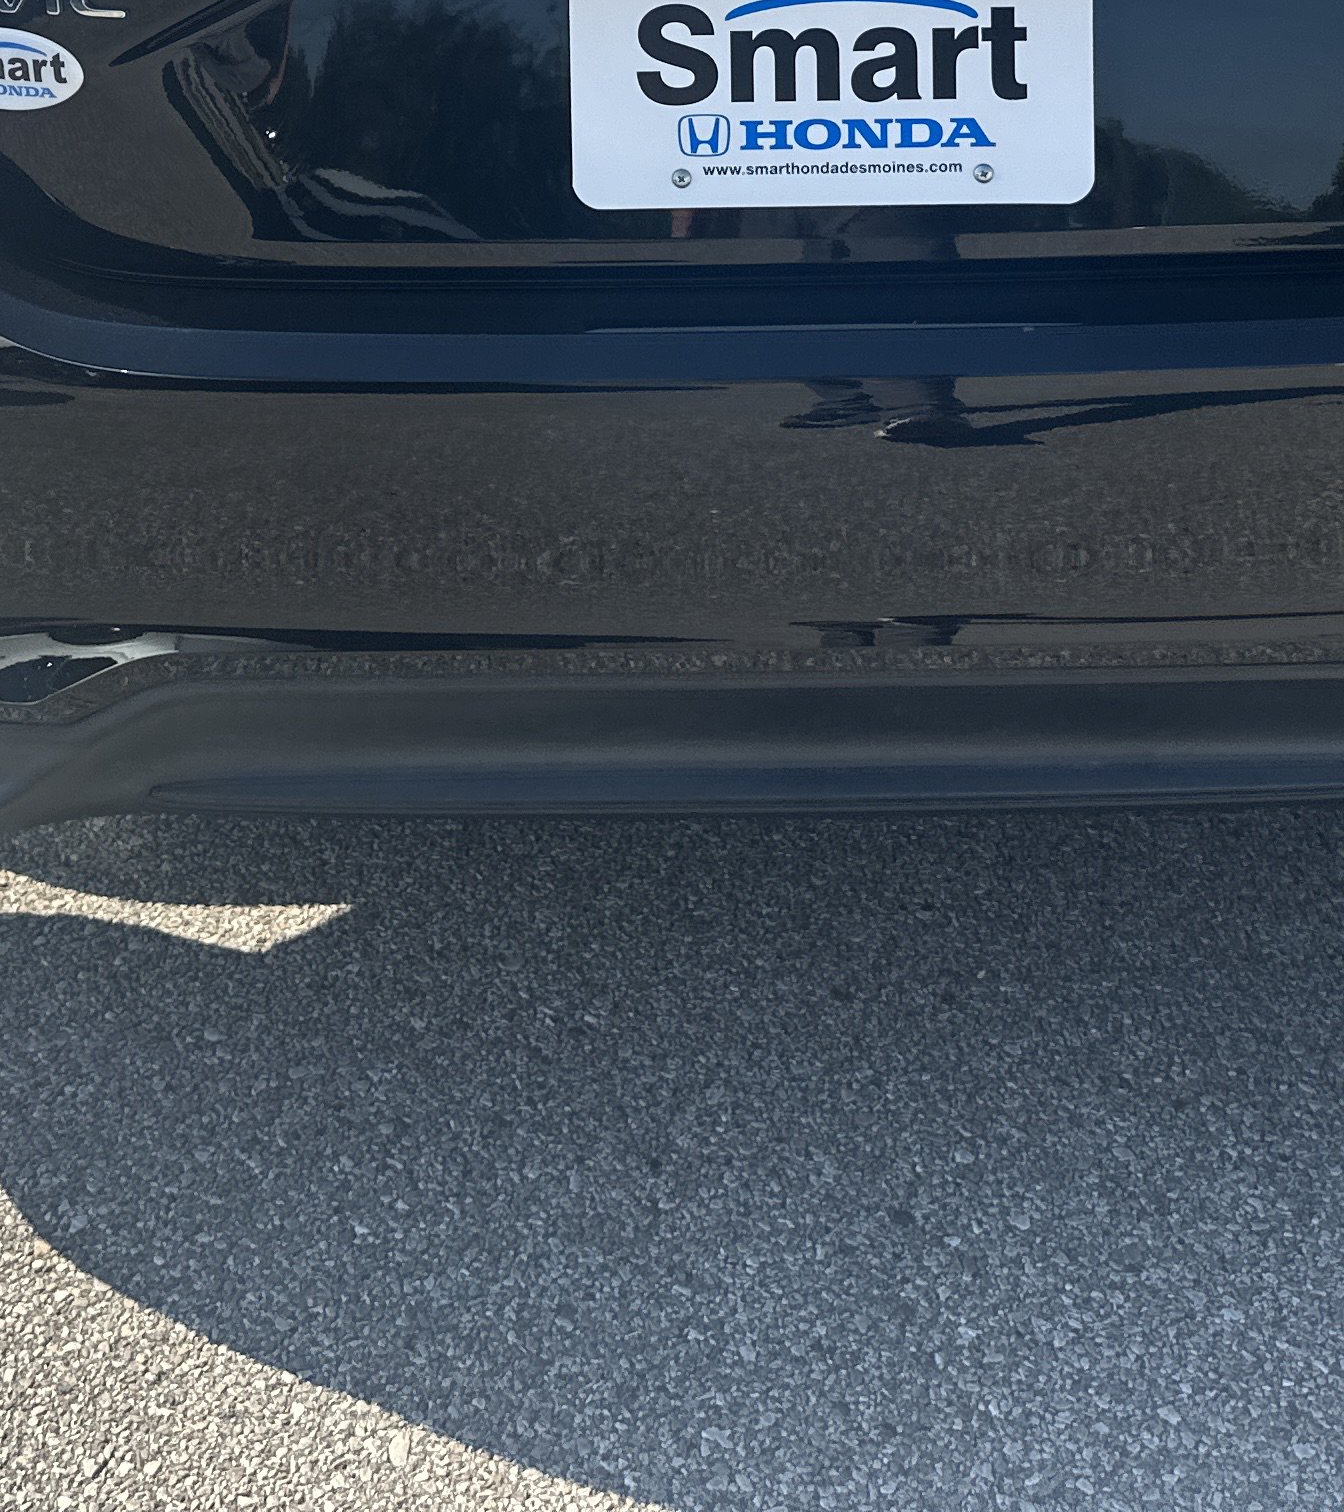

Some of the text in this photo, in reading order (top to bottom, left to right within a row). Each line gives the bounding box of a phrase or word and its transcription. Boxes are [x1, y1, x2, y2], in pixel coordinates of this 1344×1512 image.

[636, 4, 1028, 106] Smart
[739, 117, 996, 151] HONDA
[703, 161, 963, 176] www.smarthondadesmoines.com
